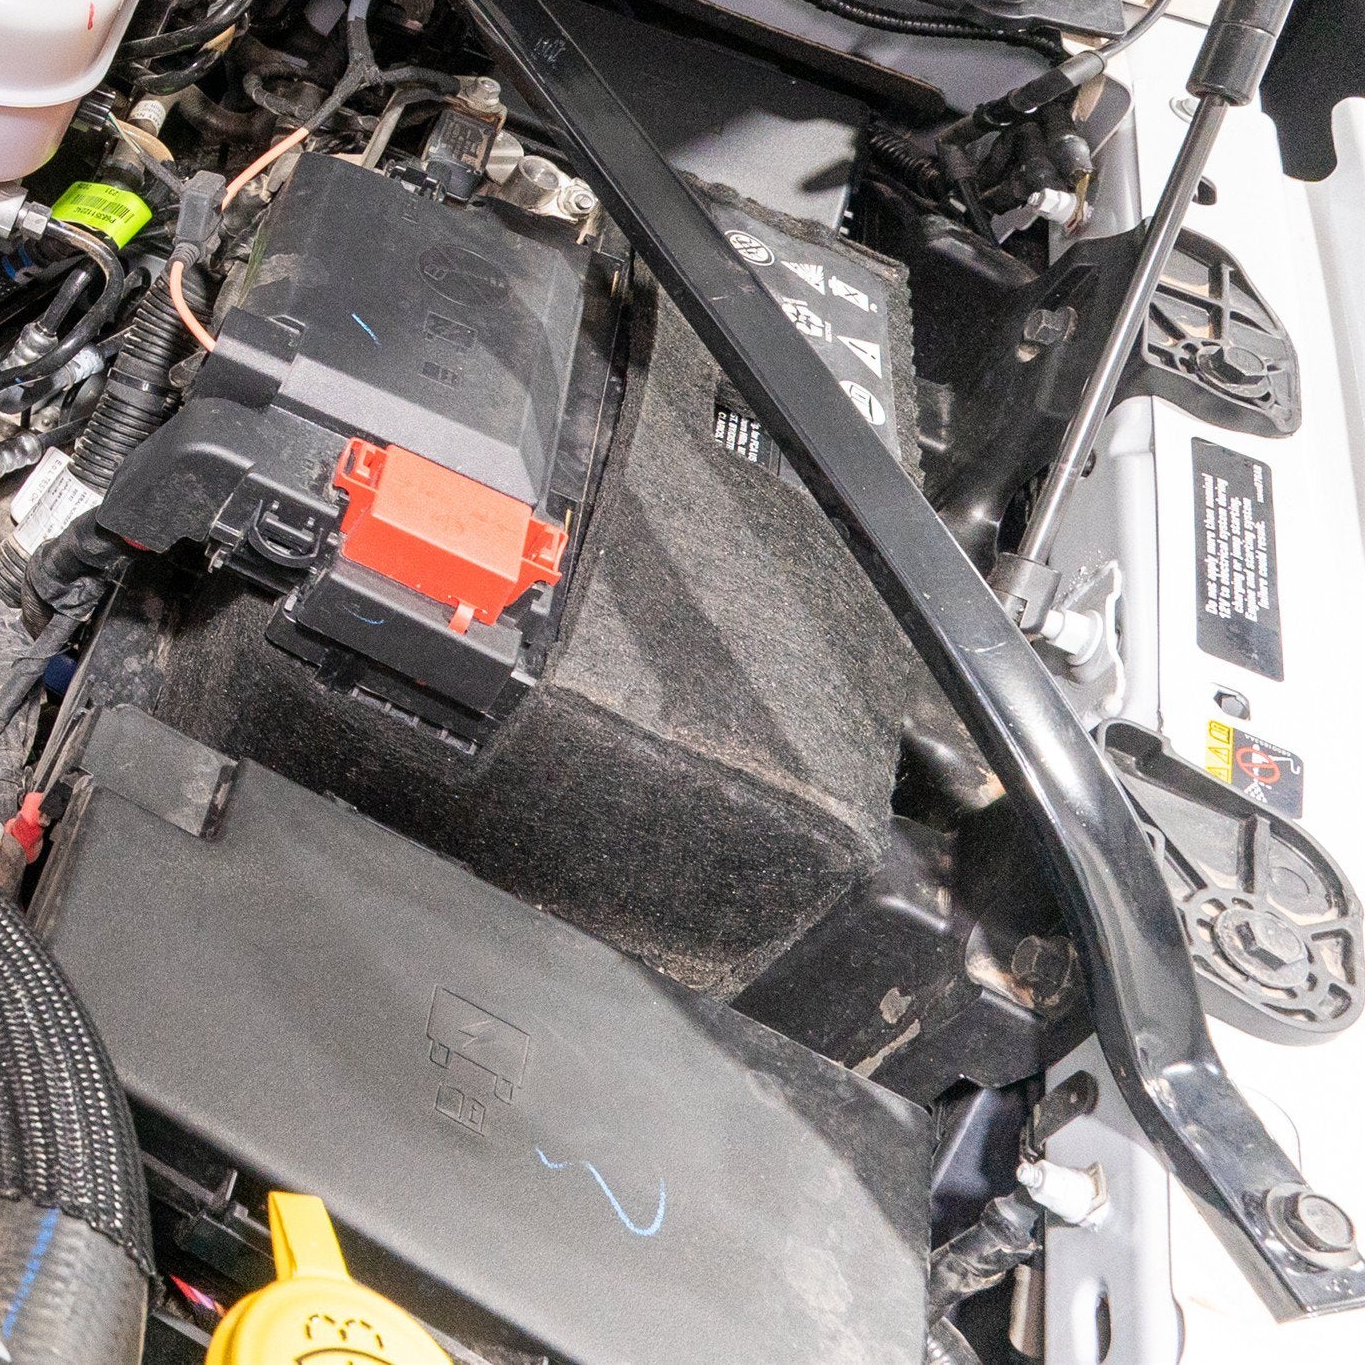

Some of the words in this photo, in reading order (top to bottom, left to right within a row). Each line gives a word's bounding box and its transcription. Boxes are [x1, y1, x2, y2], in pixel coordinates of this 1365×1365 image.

[1217, 538, 1230, 585] electrical
[1242, 529, 1257, 571] starting
[1255, 549, 1268, 577] could
[1219, 584, 1230, 599] to
[1244, 568, 1255, 589] and
[1257, 576, 1270, 609] failure
[1219, 596, 1231, 620] 12V
[1244, 586, 1259, 622] Engine
